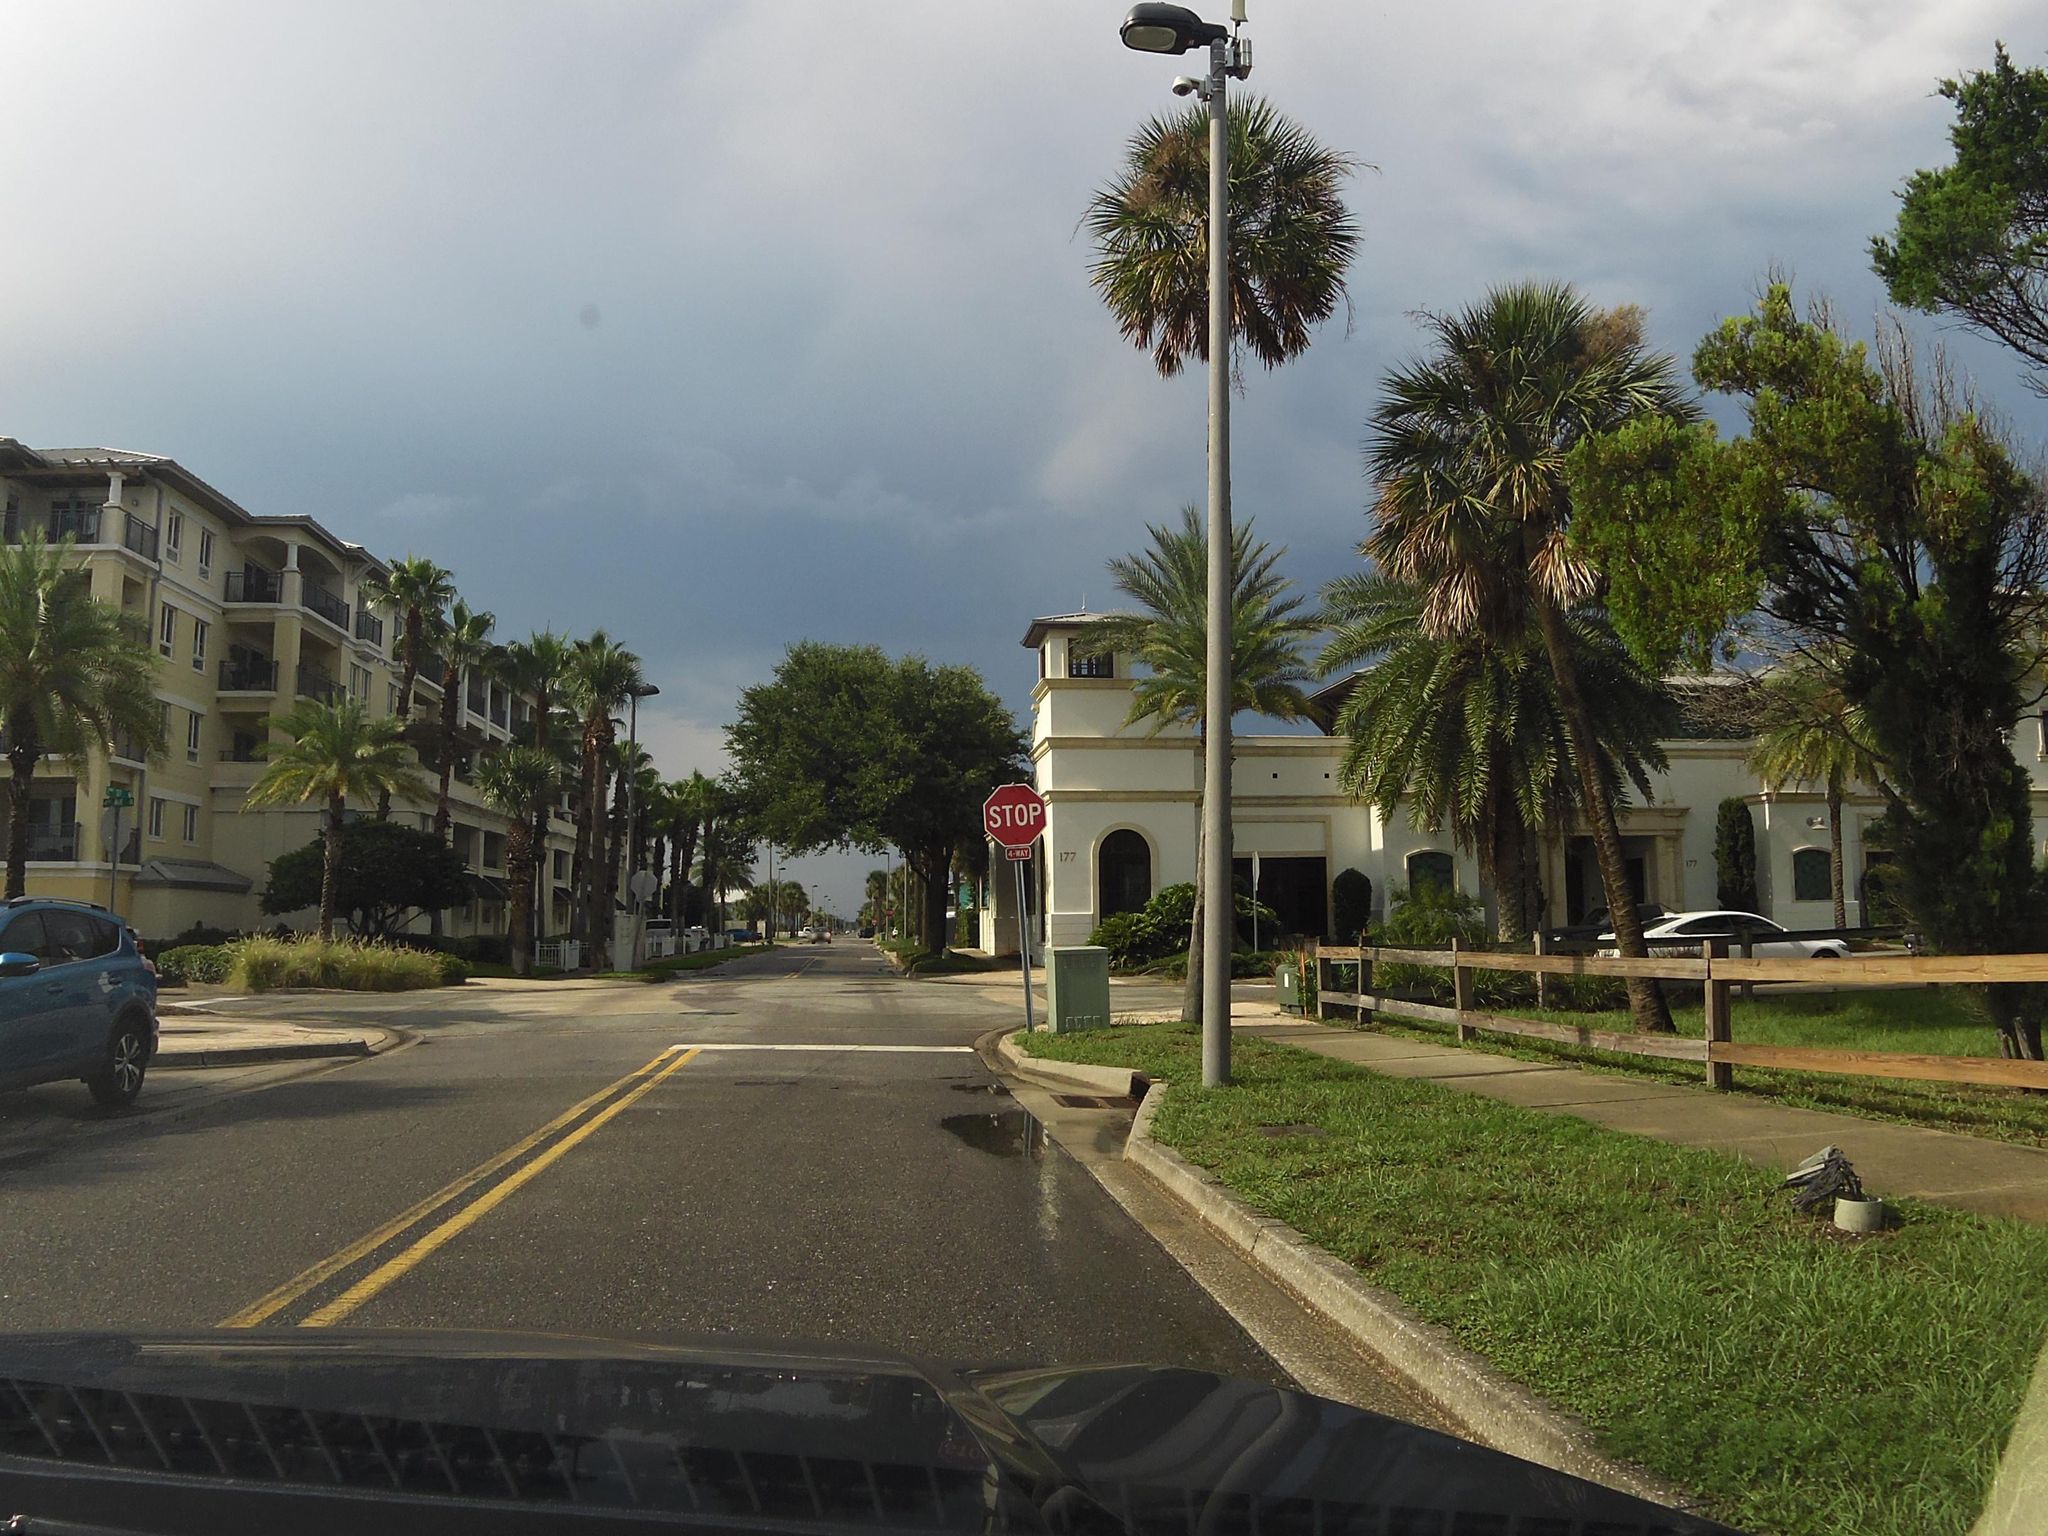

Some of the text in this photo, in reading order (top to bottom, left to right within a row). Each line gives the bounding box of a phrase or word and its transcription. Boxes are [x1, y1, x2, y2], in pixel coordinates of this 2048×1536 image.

[989, 803, 1042, 828] STOP
[1008, 849, 1029, 858] 4-WAY
[1060, 851, 1077, 862] 177
